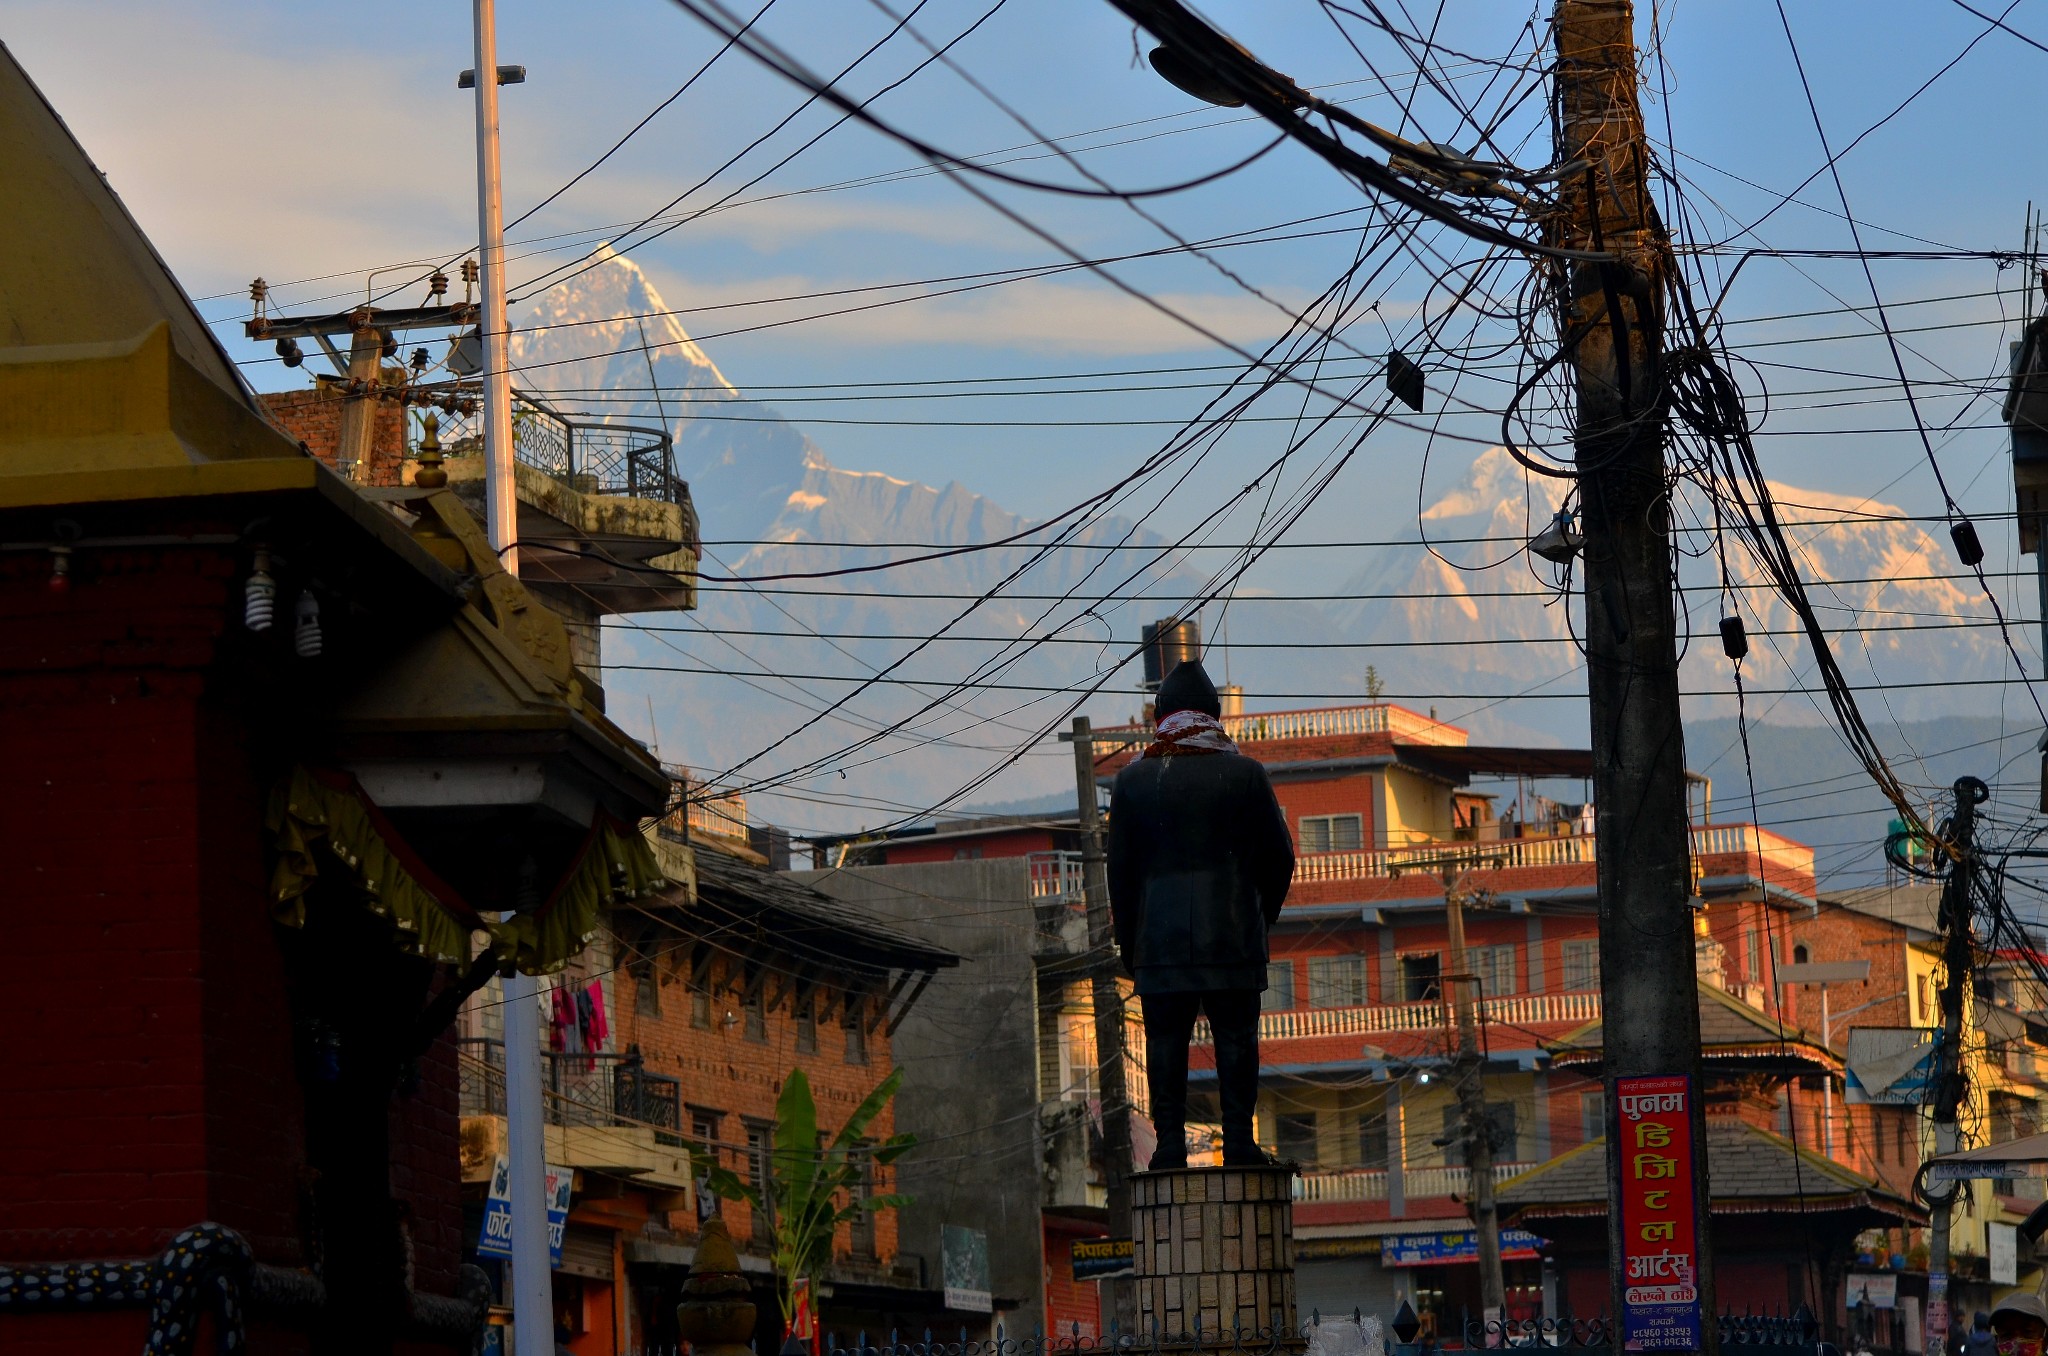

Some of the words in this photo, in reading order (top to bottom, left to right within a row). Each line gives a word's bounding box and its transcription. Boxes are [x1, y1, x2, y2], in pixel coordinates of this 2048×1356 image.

[1619, 1093, 1684, 1120] पुनम
[1073, 1241, 1113, 1258] नेपाल
[1629, 1287, 1666, 1303] लेख्ने
